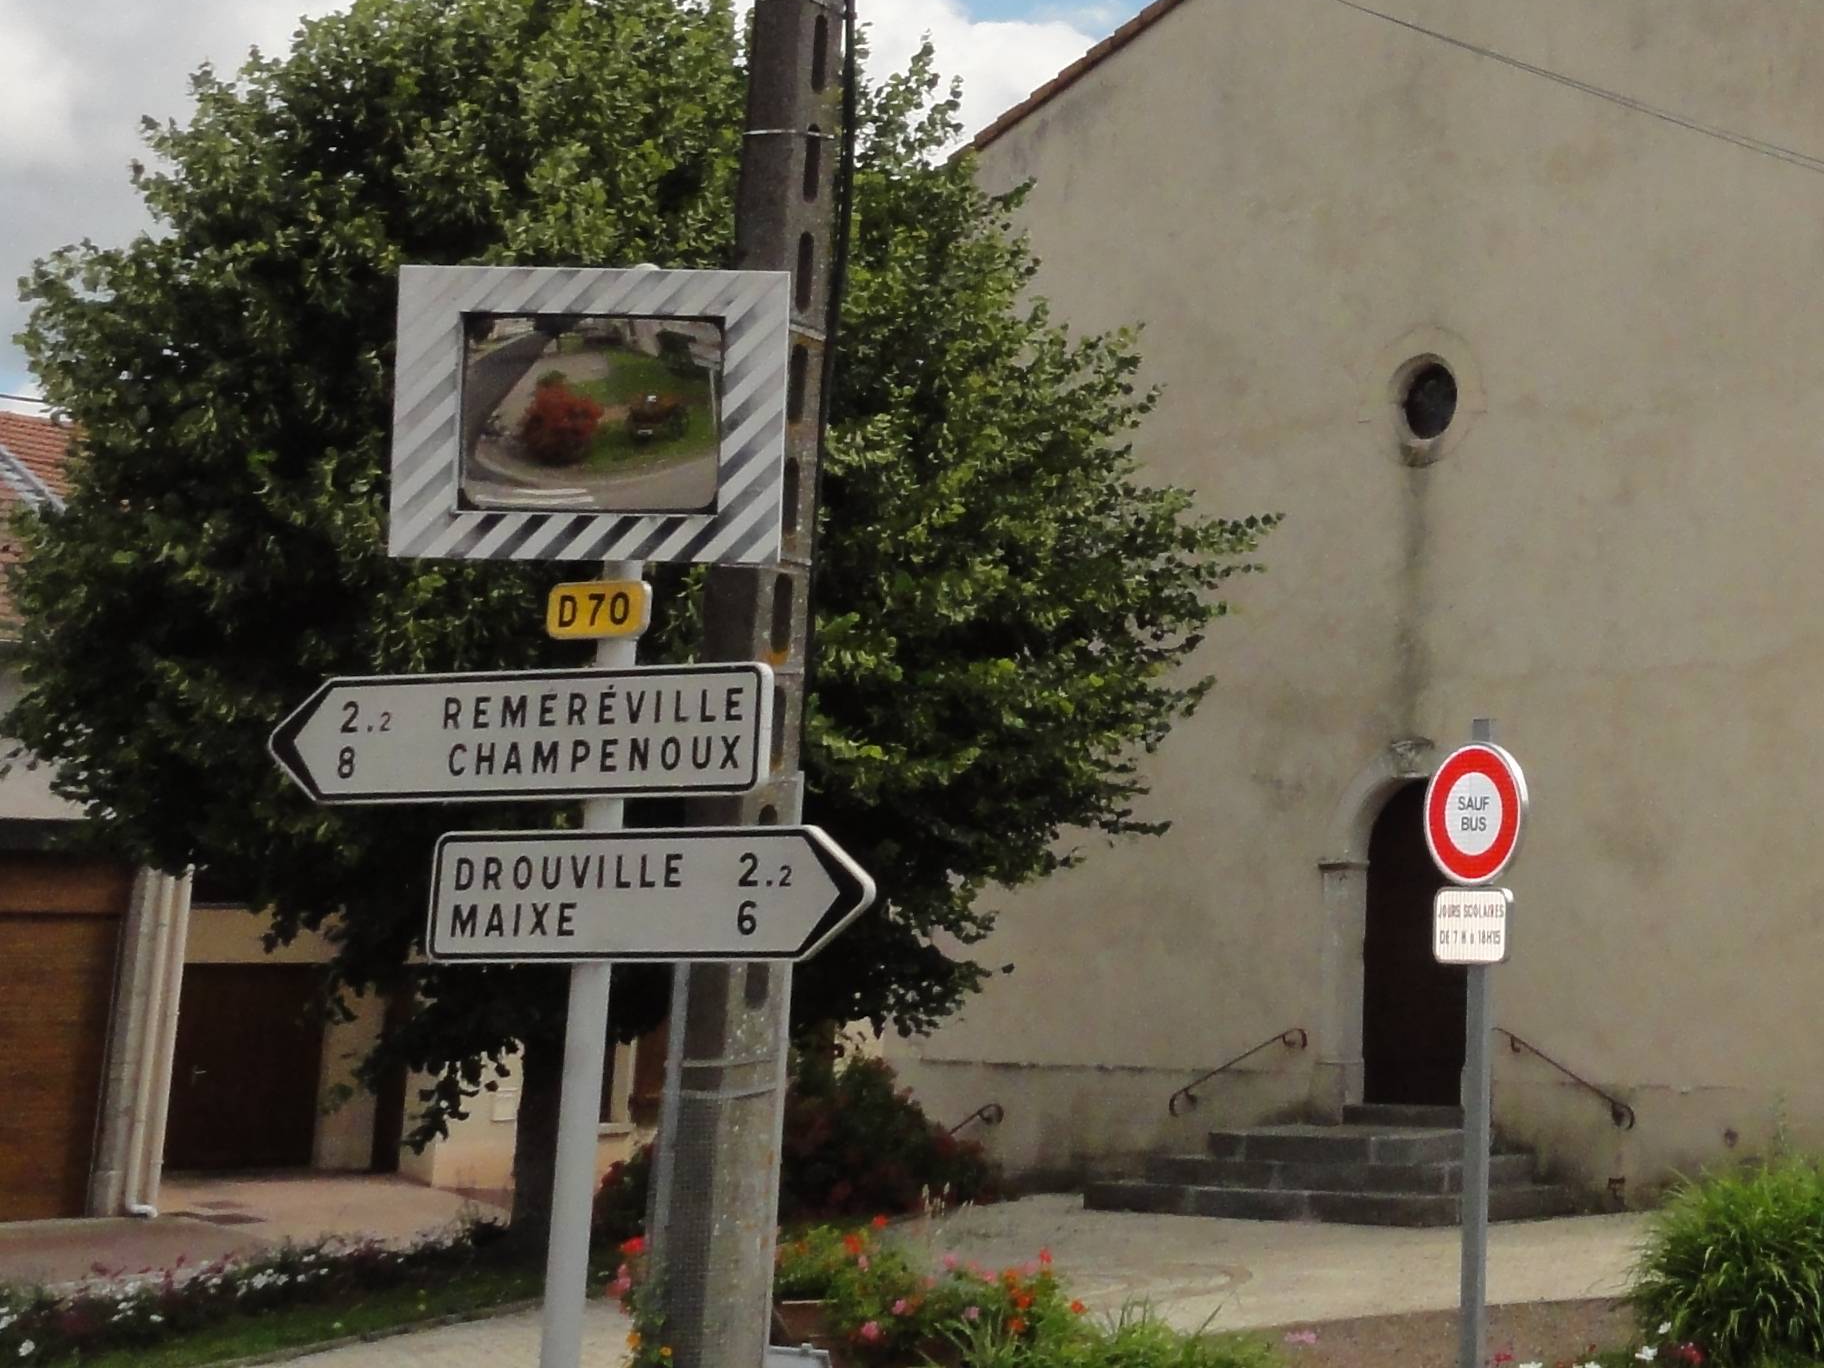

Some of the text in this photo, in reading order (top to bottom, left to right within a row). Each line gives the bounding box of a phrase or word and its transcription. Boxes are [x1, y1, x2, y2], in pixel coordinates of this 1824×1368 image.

[341, 700, 391, 733] 2.2
[338, 735, 741, 779] 8 CHAMPENOUX
[1458, 796, 1490, 811] SAUF
[1461, 816, 1487, 832] BUS
[454, 852, 793, 891] DROUVILLE 2.2
[450, 900, 758, 938] MAIXE 6
[1438, 904, 1505, 919] JOURS SCOLAIRES
[1440, 930, 1449, 944] DE
